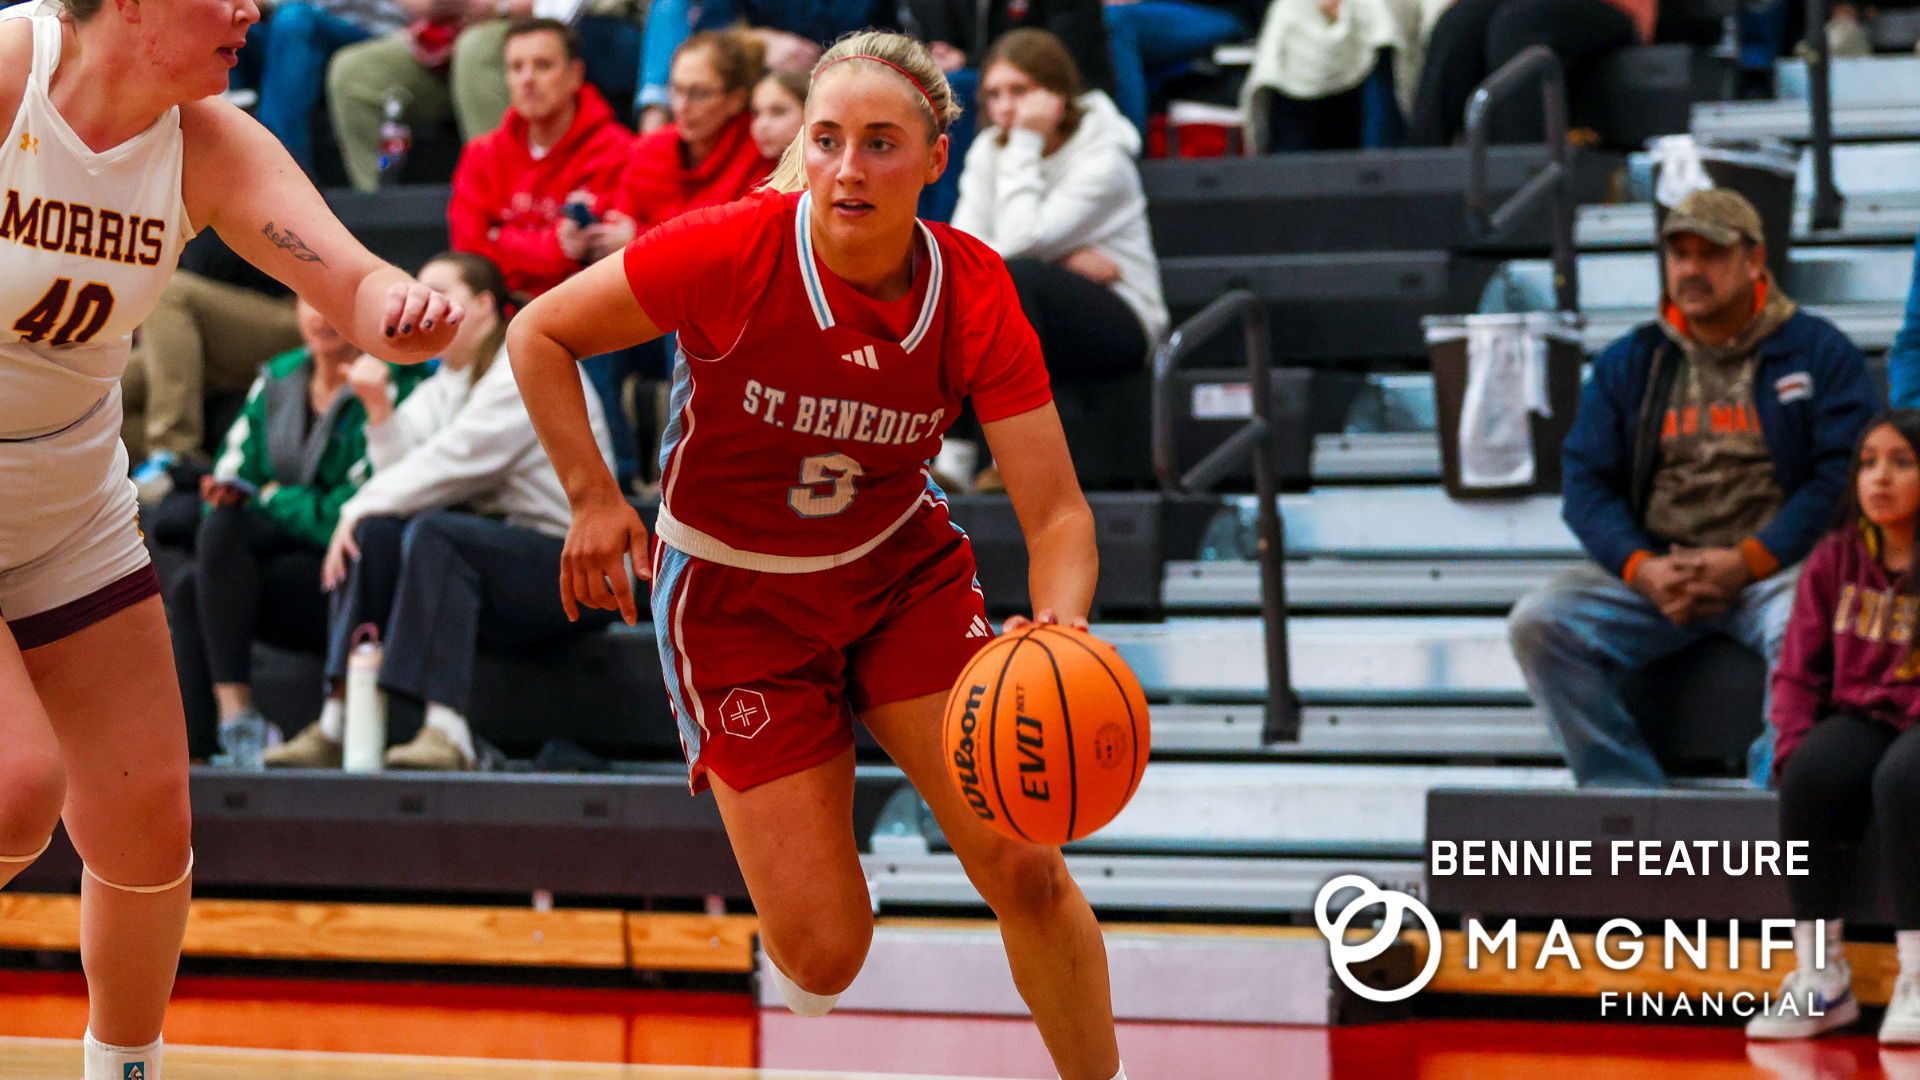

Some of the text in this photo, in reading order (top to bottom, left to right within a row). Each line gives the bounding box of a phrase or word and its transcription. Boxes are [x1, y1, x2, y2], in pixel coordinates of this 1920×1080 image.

[0, 189, 165, 266] MORRIS
[12, 277, 115, 347] 40
[742, 378, 945, 445] ST. BENEDICT
[954, 684, 995, 820] Wilson
[1016, 715, 1049, 802] EVO
